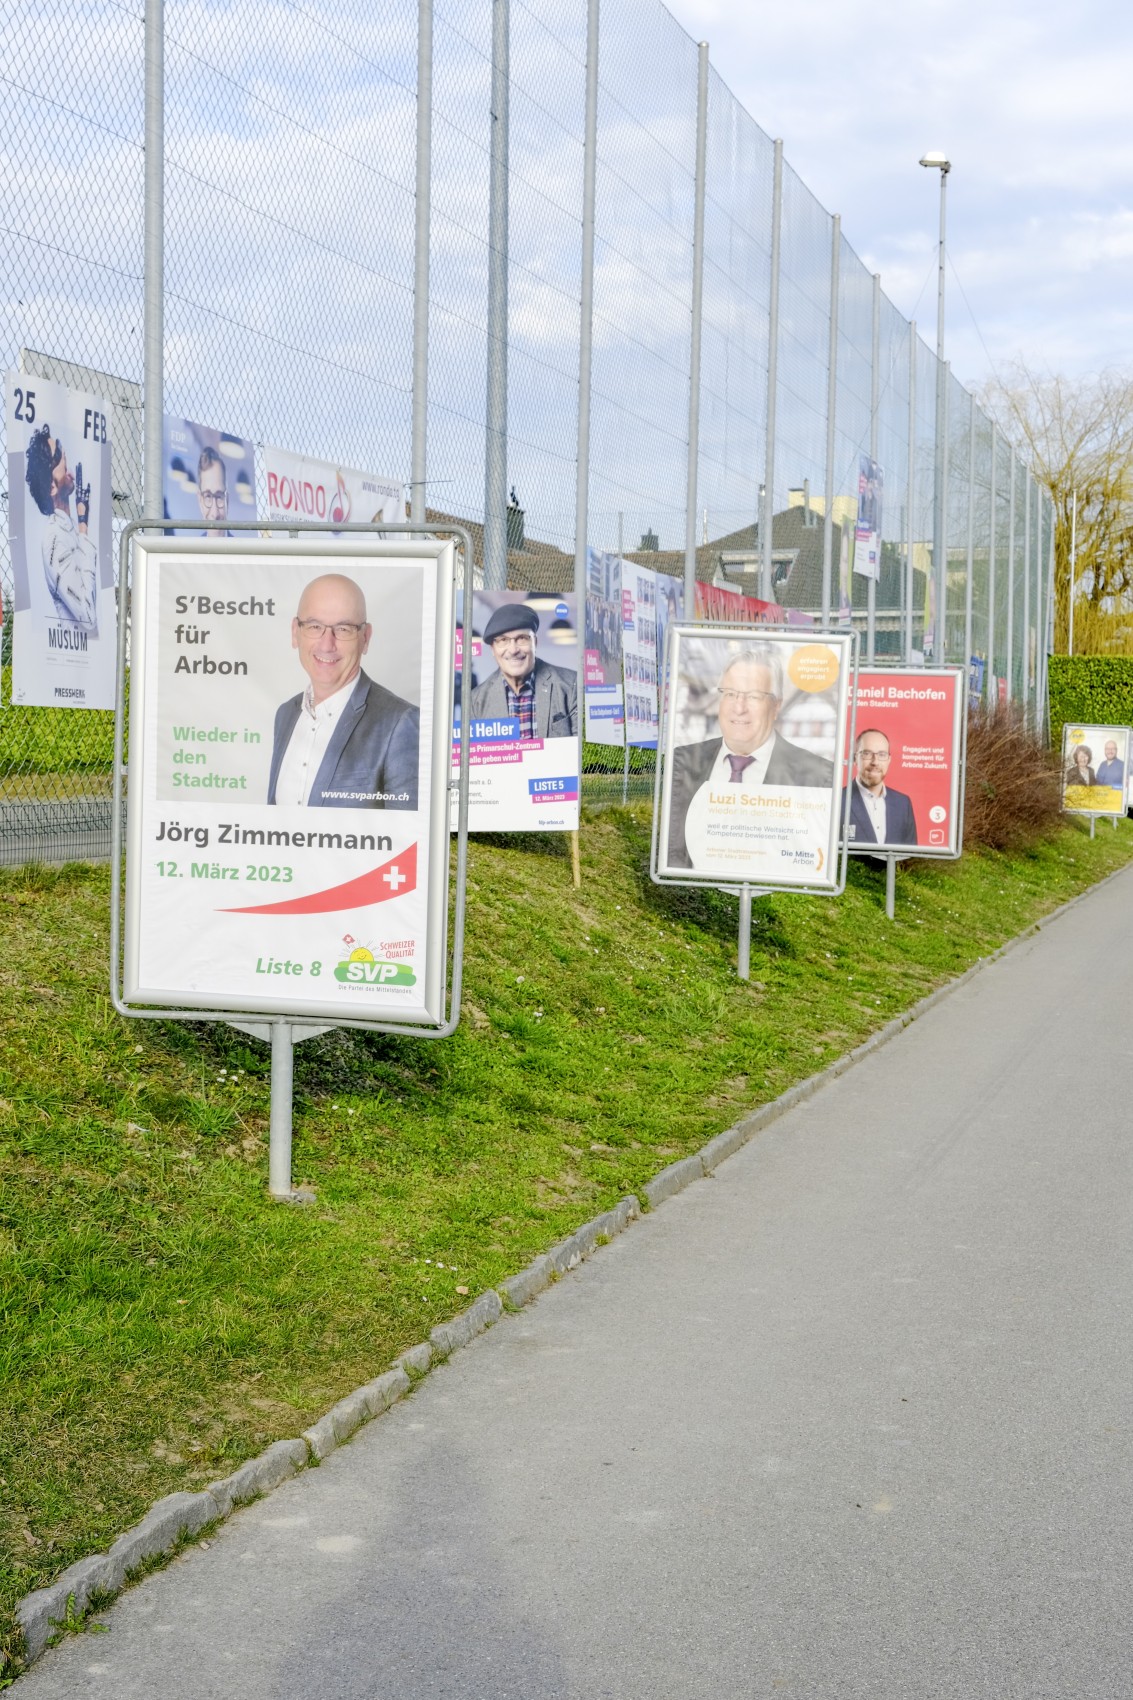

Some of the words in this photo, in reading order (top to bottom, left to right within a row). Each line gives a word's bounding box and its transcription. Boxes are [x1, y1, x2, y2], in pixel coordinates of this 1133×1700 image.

[13, 387, 36, 424] 25
[83, 408, 107, 445] FEB
[267, 471, 326, 519] RONDO
[48, 623, 88, 652] MÜSLÜM
[174, 624, 211, 644] für
[174, 655, 248, 675] Arbon
[797, 665, 830, 674] engagiert
[800, 673, 826, 681] erprobt
[54, 687, 86, 699] PRESSWERK
[888, 687, 946, 700] Bachofen
[869, 700, 899, 708] Stadtrat
[173, 726, 238, 743] Wieder
[243, 728, 261, 743] in
[475, 722, 514, 737] Heller
[476, 742, 541, 753] Primarschul-Zentrum
[902, 745, 932, 754] Engagiert
[172, 749, 207, 765] den
[470, 756, 482, 764] alle
[482, 755, 500, 765] geben
[501, 753, 519, 762] wird!
[902, 753, 934, 762] kompetent
[172, 772, 247, 789] Stadtrat
[534, 781, 558, 792] LISTE
[558, 780, 565, 790] 5
[321, 790, 410, 802] www.svparbon.ch
[709, 792, 736, 805] Luzi
[740, 794, 792, 808] Schmid
[708, 806, 737, 815] wieder
[740, 808, 748, 816] in
[751, 809, 767, 817] den
[935, 812, 941, 820] 3
[706, 830, 744, 839] Kompetenz
[744, 832, 777, 840] bewiesen
[730, 824, 762, 832] politische
[764, 826, 794, 834] Weitsicht
[155, 821, 209, 849] Jörg
[217, 823, 393, 851] Zimmermann
[781, 849, 793, 857] Die
[795, 850, 815, 858] Mitte
[155, 861, 184, 878] 12.
[190, 862, 239, 881] März
[246, 865, 293, 883] 2023
[255, 957, 304, 977] Liste
[309, 960, 323, 977] 8
[346, 962, 399, 983] SVP
[376, 986, 413, 994] Mittelstandes
